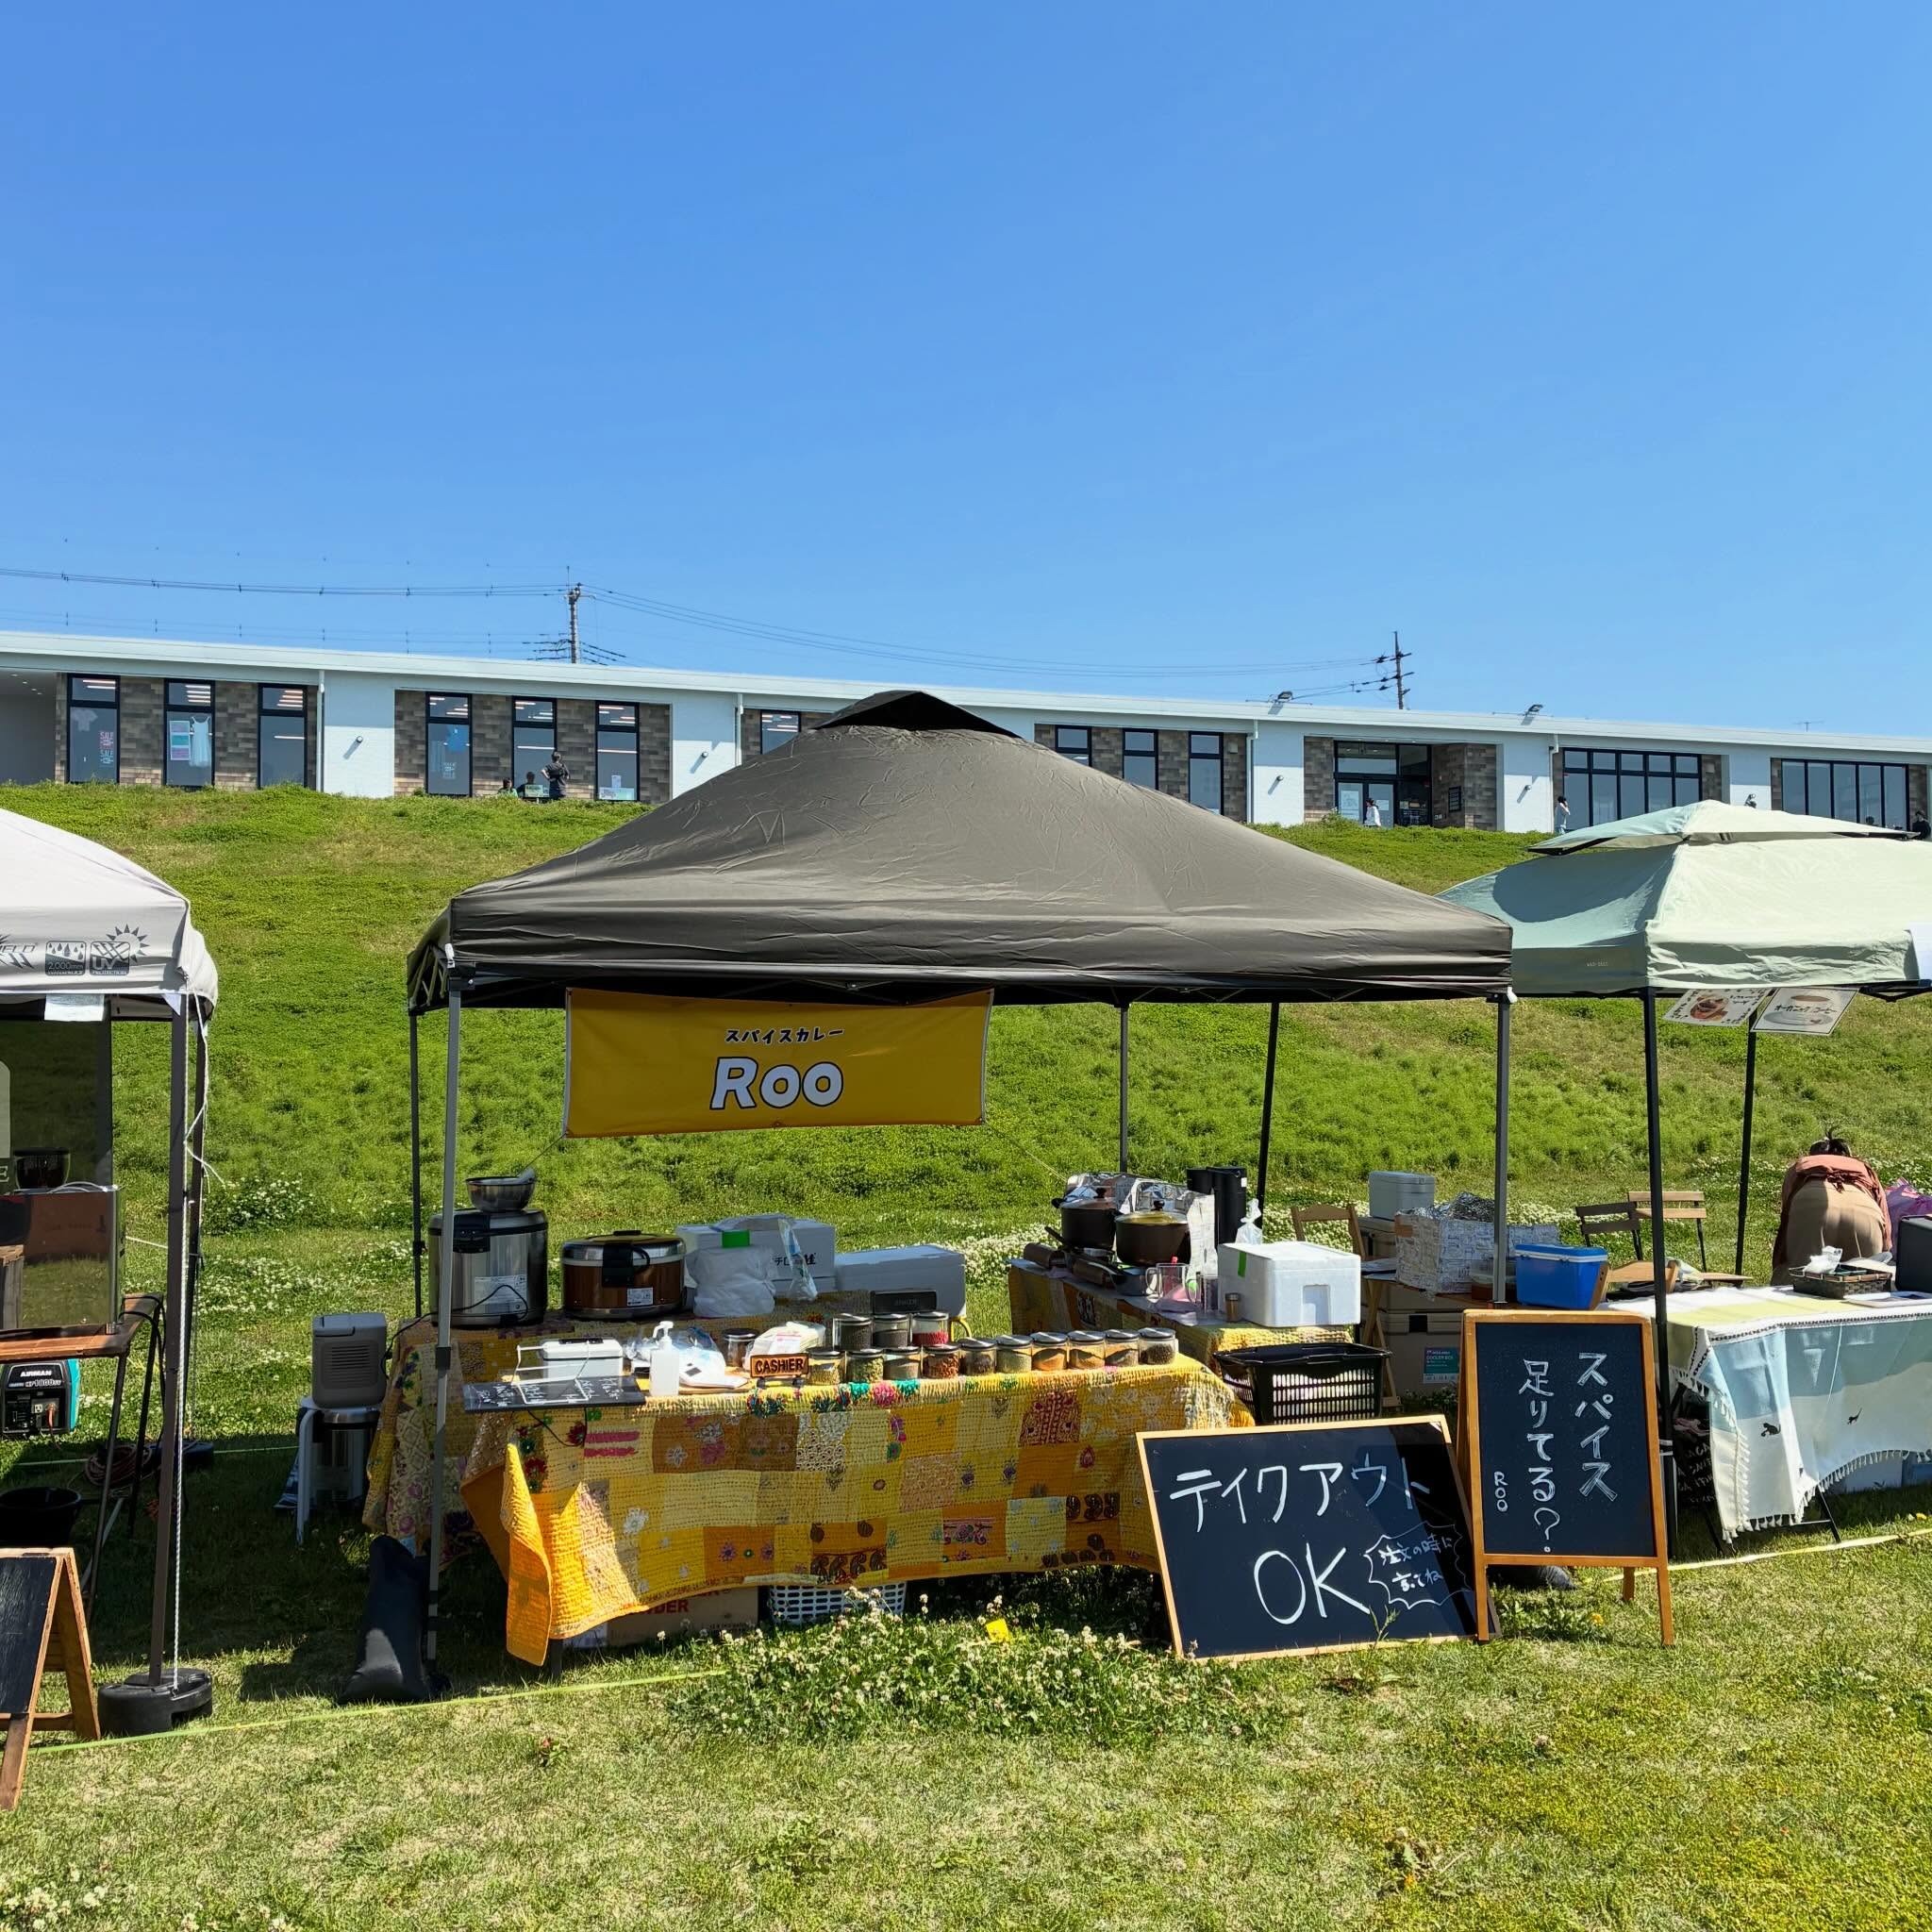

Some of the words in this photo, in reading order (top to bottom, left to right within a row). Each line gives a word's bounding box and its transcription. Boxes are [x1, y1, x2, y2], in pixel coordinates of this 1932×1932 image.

[92, 957, 117, 970] UV
[724, 1027, 844, 1044] スパイスカレー
[755, 1357, 804, 1374] CASHIER
[1574, 1352, 1618, 1502] スパイス
[1169, 1453, 1430, 1533] テイクアウト
[1378, 1532, 1454, 1566] 注文の時に
[1253, 1541, 1371, 1625] OK
[1391, 1568, 1444, 1592] 言ってね
